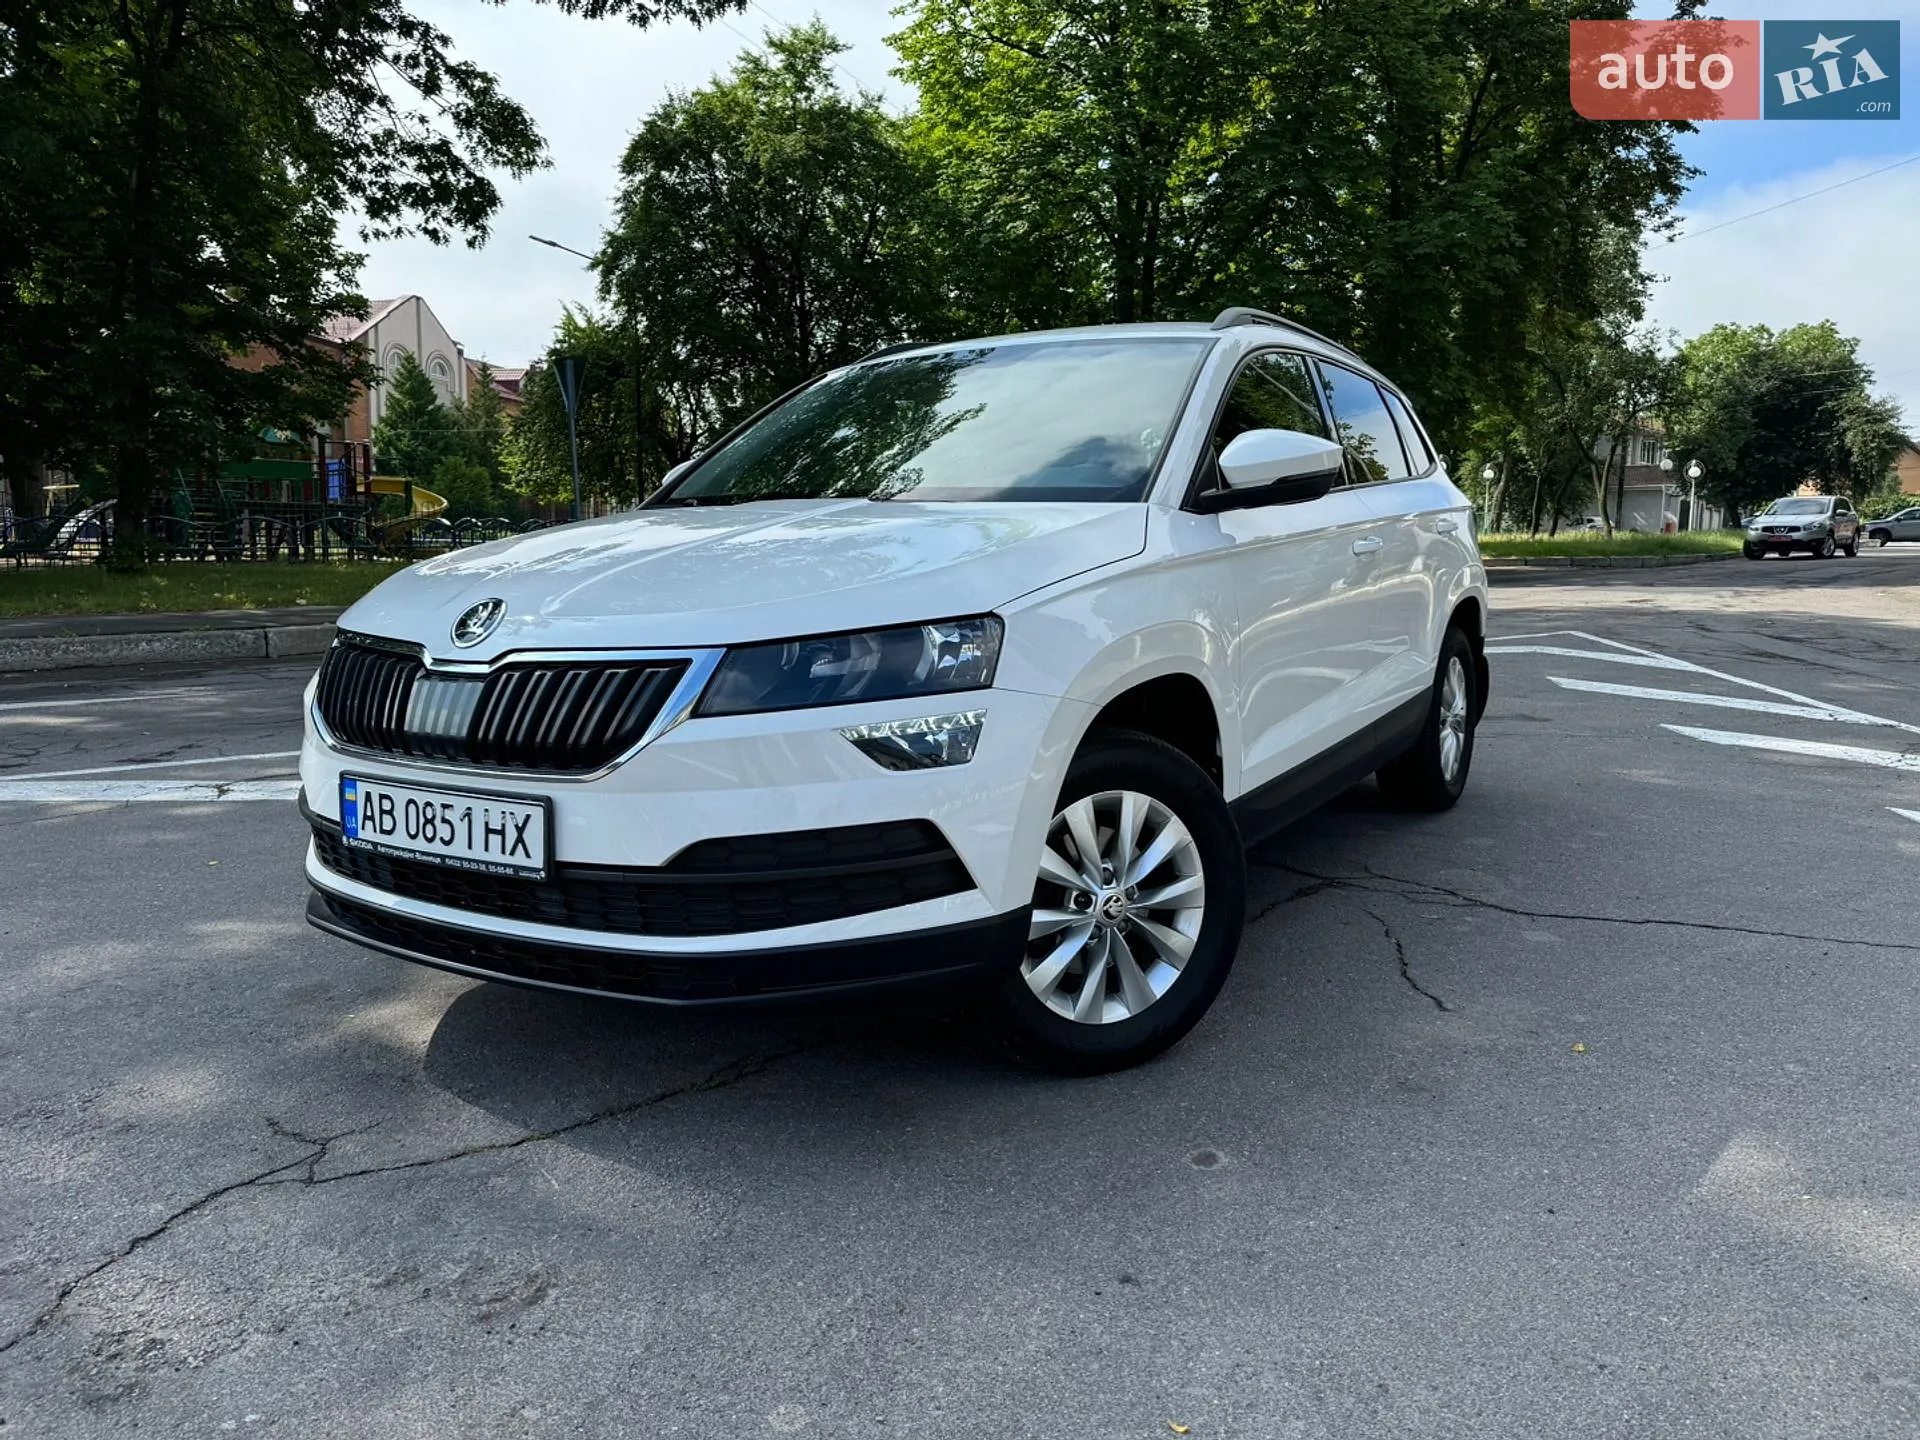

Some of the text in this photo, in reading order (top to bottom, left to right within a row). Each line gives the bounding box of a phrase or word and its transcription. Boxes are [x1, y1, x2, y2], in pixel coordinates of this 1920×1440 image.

[361, 790, 533, 860] AB 0851 HX
